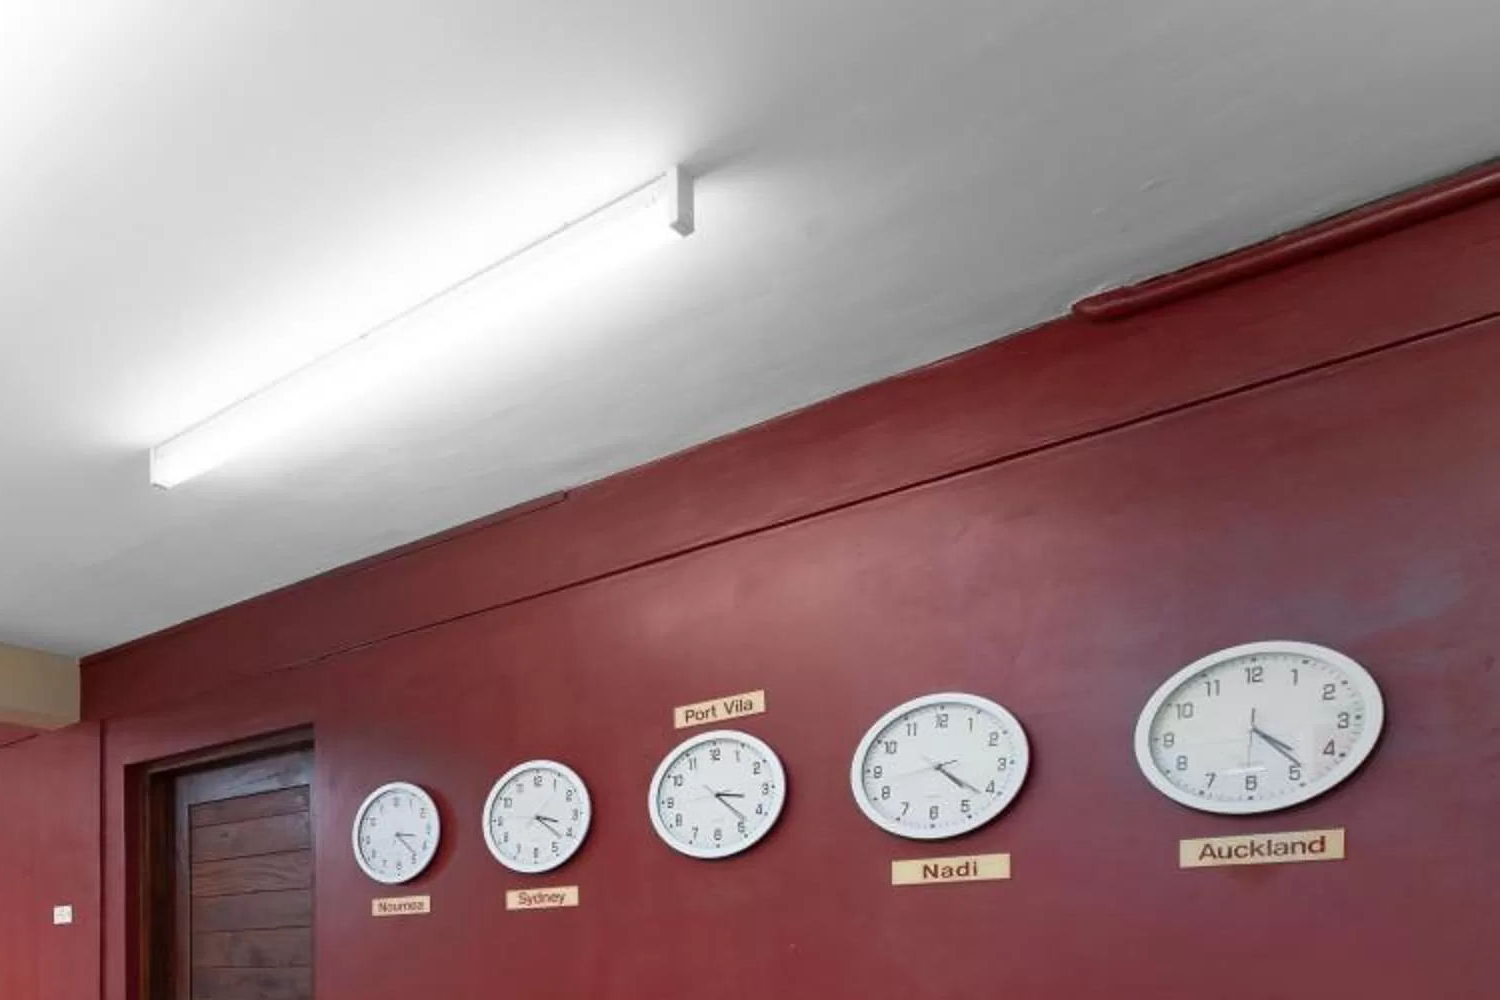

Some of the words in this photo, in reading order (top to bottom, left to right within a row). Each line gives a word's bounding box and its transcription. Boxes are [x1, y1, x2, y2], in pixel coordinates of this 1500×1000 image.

[1244, 666, 1264, 684] 12
[1291, 669, 1299, 686] 1
[1204, 680, 1221, 697] 11
[1322, 684, 1336, 700] 2
[685, 704, 717, 724] Port
[723, 698, 753, 716] Vila
[1176, 703, 1194, 720] 10
[935, 713, 949, 728] 12
[968, 717, 973, 732] 1
[1337, 712, 1349, 729] 3
[906, 723, 917, 737] 11
[988, 732, 999, 747] 2
[1163, 732, 1174, 749] 9
[709, 747, 721, 761] 12
[884, 740, 897, 755] 10
[1323, 740, 1336, 756] 4
[688, 758, 697, 771] 11
[753, 762, 761, 775] 2
[998, 757, 1007, 771] 3
[1176, 755, 1188, 771] 8
[873, 765, 882, 779] 9
[1289, 764, 1301, 781] 5
[673, 774, 684, 787] 10
[985, 780, 995, 794] 4
[1205, 772, 1217, 789] 7
[1245, 774, 1257, 791] 6
[762, 783, 769, 795] 3
[881, 786, 890, 800] 8
[901, 801, 909, 816] 7
[929, 805, 939, 820] 6
[961, 800, 970, 813] 5
[692, 827, 699, 839] 7
[1199, 835, 1326, 861] Auckland
[922, 861, 978, 880] Nadi
[518, 891, 566, 906] Sydney
